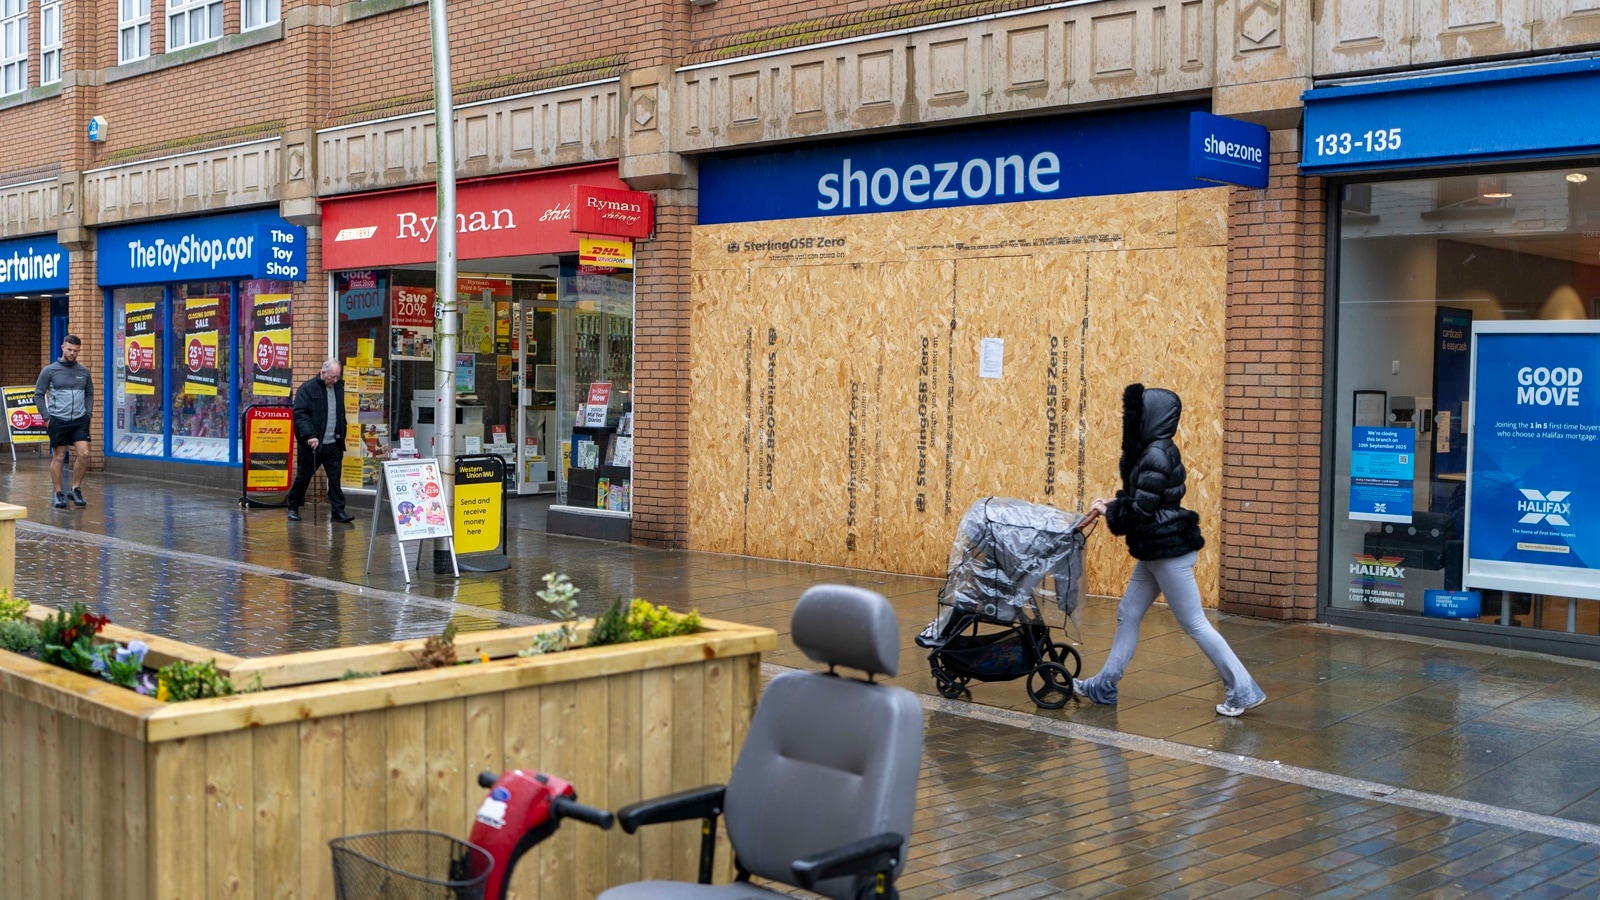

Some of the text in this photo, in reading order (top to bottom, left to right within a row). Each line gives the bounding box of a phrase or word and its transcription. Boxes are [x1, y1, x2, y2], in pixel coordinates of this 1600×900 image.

[1204, 133, 1262, 163] shoezone
[1315, 128, 1402, 156] 133-135
[817, 151, 1060, 211] shoezone
[587, 196, 641, 212] Ryman
[270, 229, 294, 243] The
[817, 236, 846, 248] Zero
[271, 246, 293, 263] Toy
[592, 246, 620, 257] DHL
[266, 261, 299, 279] Shop
[398, 290, 428, 304] Save
[187, 311, 204, 320] CLOSING
[256, 306, 288, 317] CLOSING DOWN
[398, 302, 427, 317] 20%
[435, 307, 440, 317] 6
[127, 313, 153, 323] CLOSING DOWN
[195, 318, 209, 328] SALE
[265, 315, 280, 326] SALE
[134, 321, 147, 332] SALE
[129, 348, 140, 359] 25%
[189, 346, 202, 357] 25%
[259, 345, 272, 357] 25%
[919, 336, 929, 376] Zero
[1046, 335, 1058, 378] Zero
[260, 358, 268, 366] OFF
[1517, 366, 1583, 387] GOOD
[592, 394, 606, 402] Now
[1516, 386, 1580, 406] MOVE
[13, 414, 29, 422] 25%
[254, 410, 290, 418] Ryman
[1494, 421, 1517, 429] Joining
[1512, 430, 1535, 438] choose
[1542, 431, 1564, 439] Halifax
[1565, 433, 1598, 442] mortgage.
[460, 498, 477, 506] Send
[1517, 500, 1571, 514] HALIFAX
[463, 508, 487, 516] receive
[463, 518, 486, 526] money
[1349, 563, 1406, 579] HALIFAX
[1349, 594, 1405, 606] LGBT+ COMMUNITY
